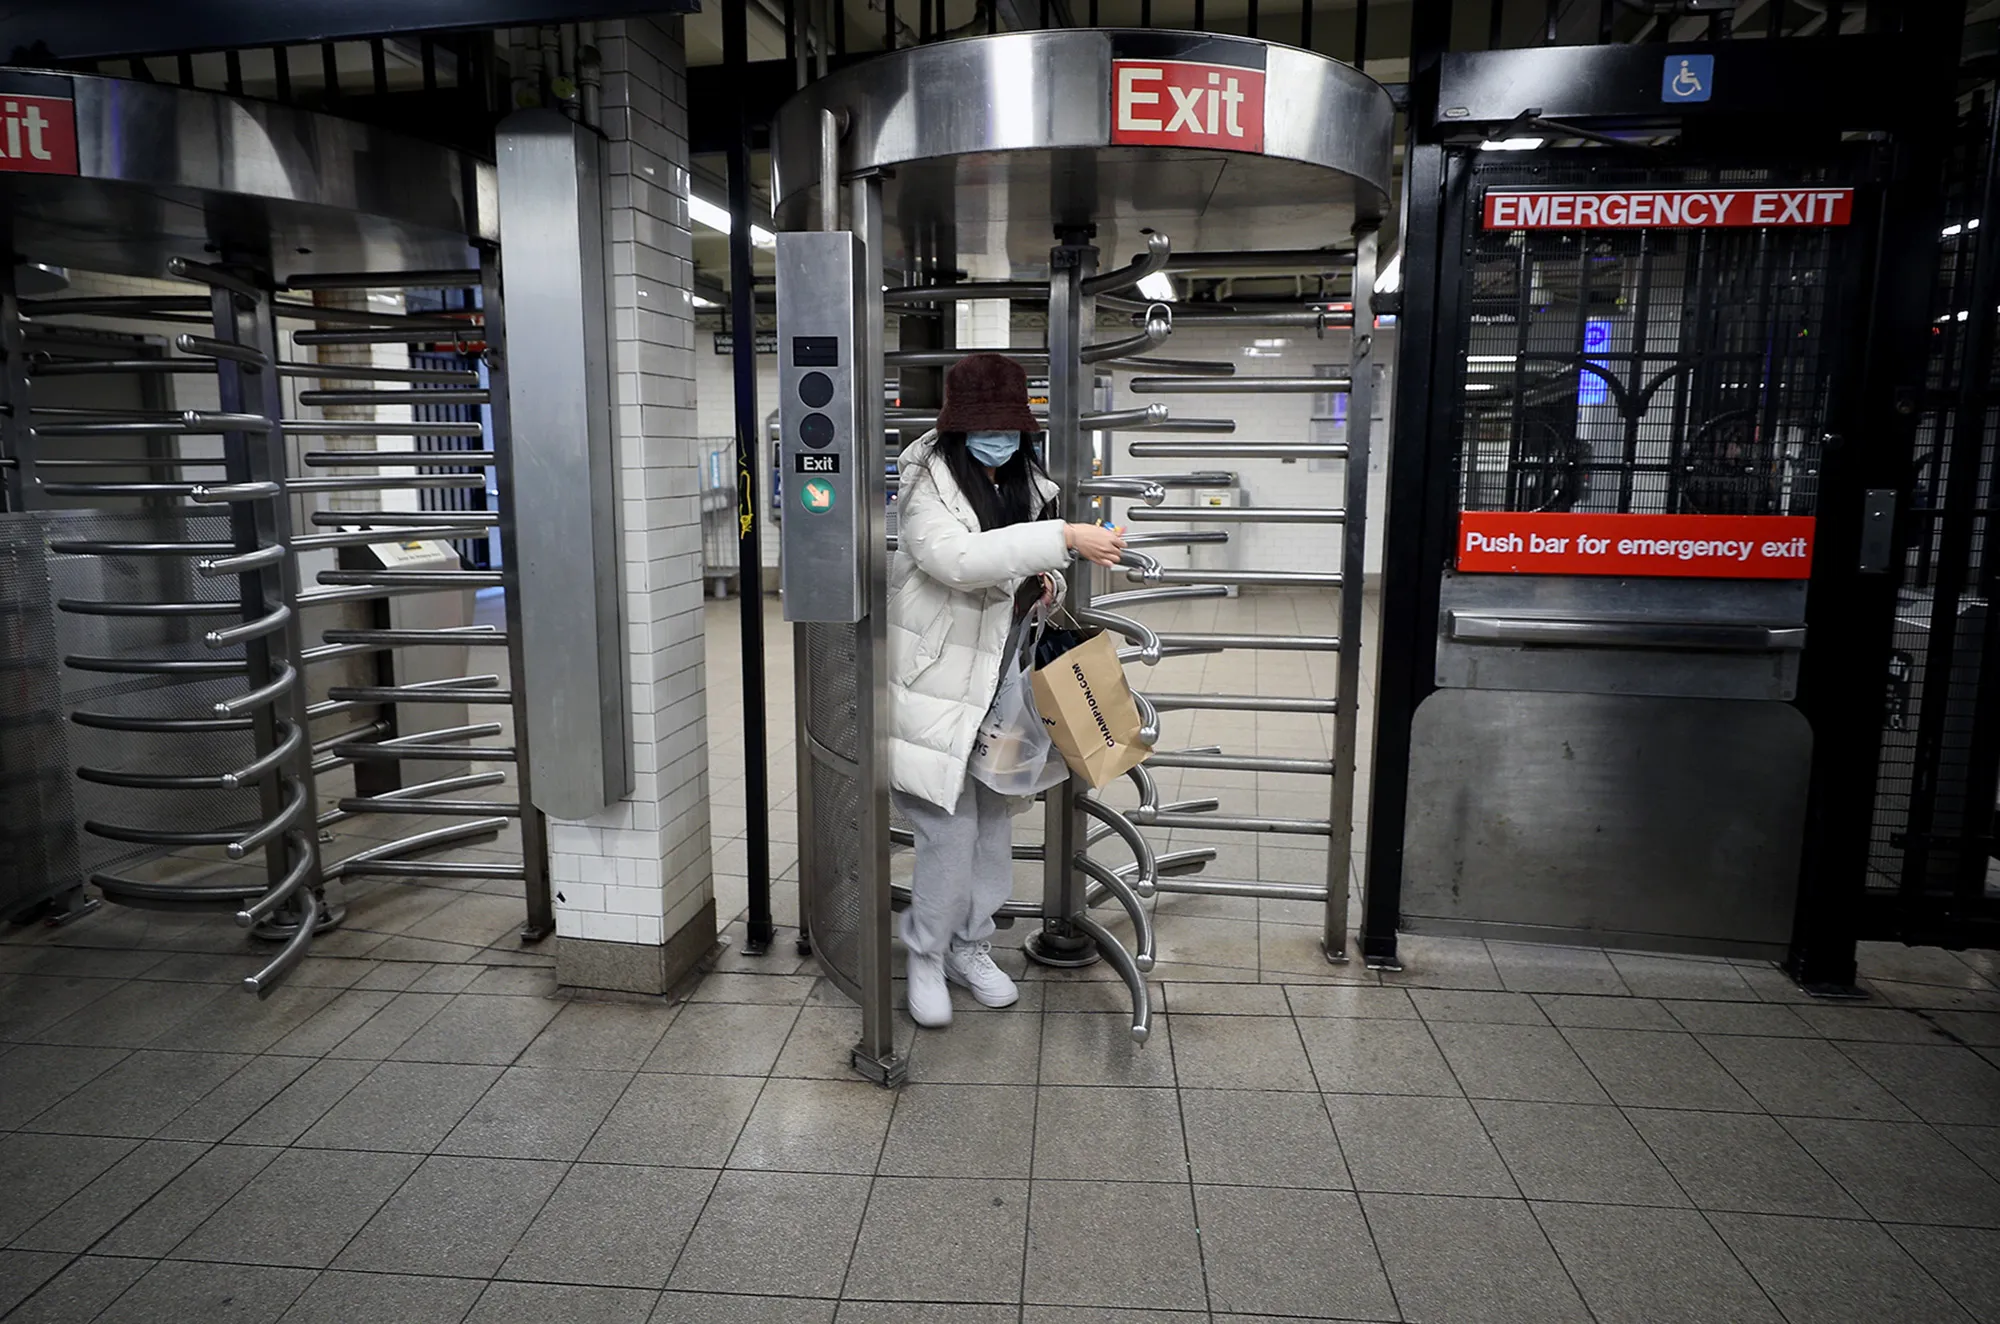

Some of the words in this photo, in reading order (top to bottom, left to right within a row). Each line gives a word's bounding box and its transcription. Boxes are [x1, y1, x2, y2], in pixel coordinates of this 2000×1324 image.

[1118, 67, 1245, 138] Exit
[0, 101, 52, 161] it
[1492, 194, 1736, 226] EMERGENCY
[1752, 193, 1845, 223] EXIT
[803, 456, 833, 471] Exit
[1466, 532, 1523, 553] Push
[1529, 533, 1569, 554] bar
[1577, 534, 1610, 555] for
[1617, 538, 1753, 561] emergency
[1761, 538, 1807, 558] exit
[1071, 662, 1115, 748] CHAMPION.COM
